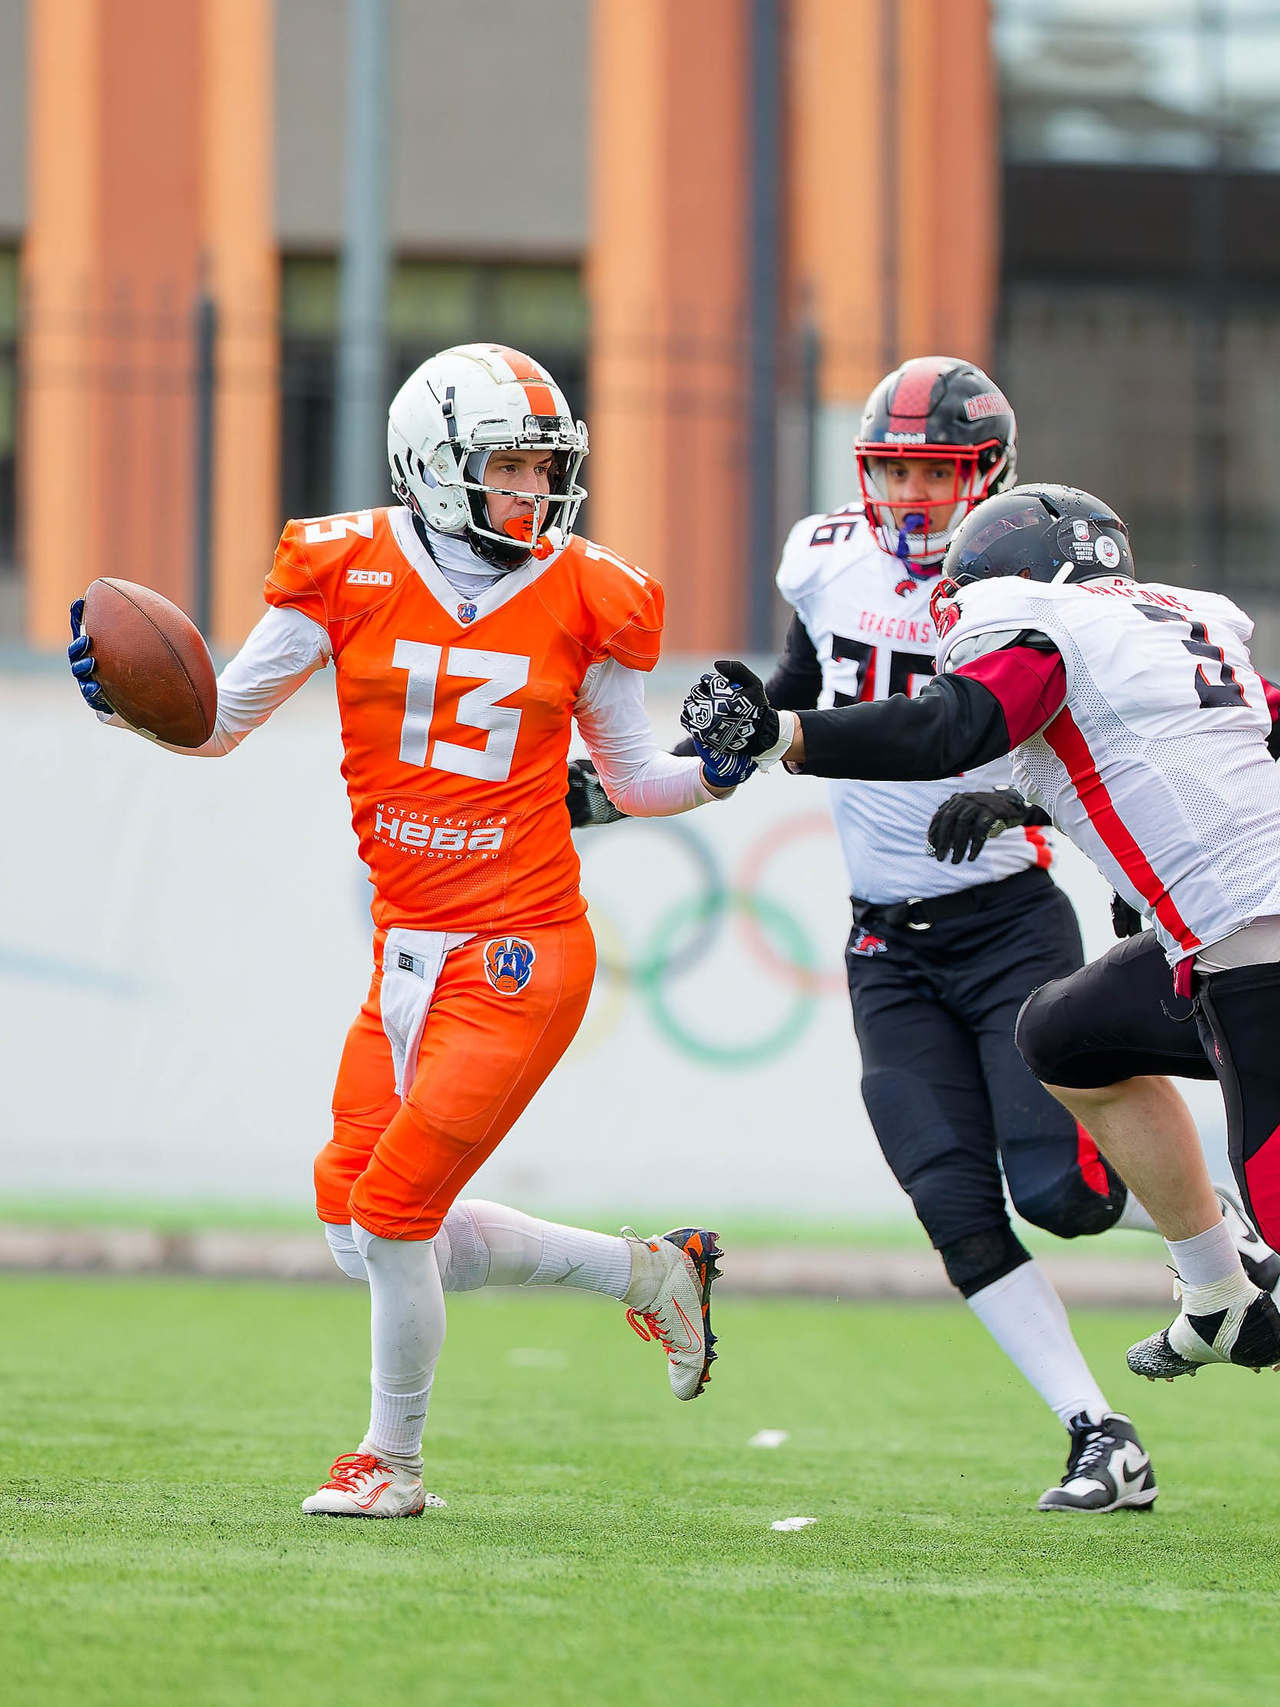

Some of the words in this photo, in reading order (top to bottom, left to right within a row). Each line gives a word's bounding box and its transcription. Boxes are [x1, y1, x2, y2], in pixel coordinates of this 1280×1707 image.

[347, 569, 392, 586] ZEDO
[859, 611, 931, 643] DRAGONS
[1132, 604, 1252, 708] 3
[391, 638, 531, 782] 13
[376, 803, 508, 827] МОТОТЕХНИКА
